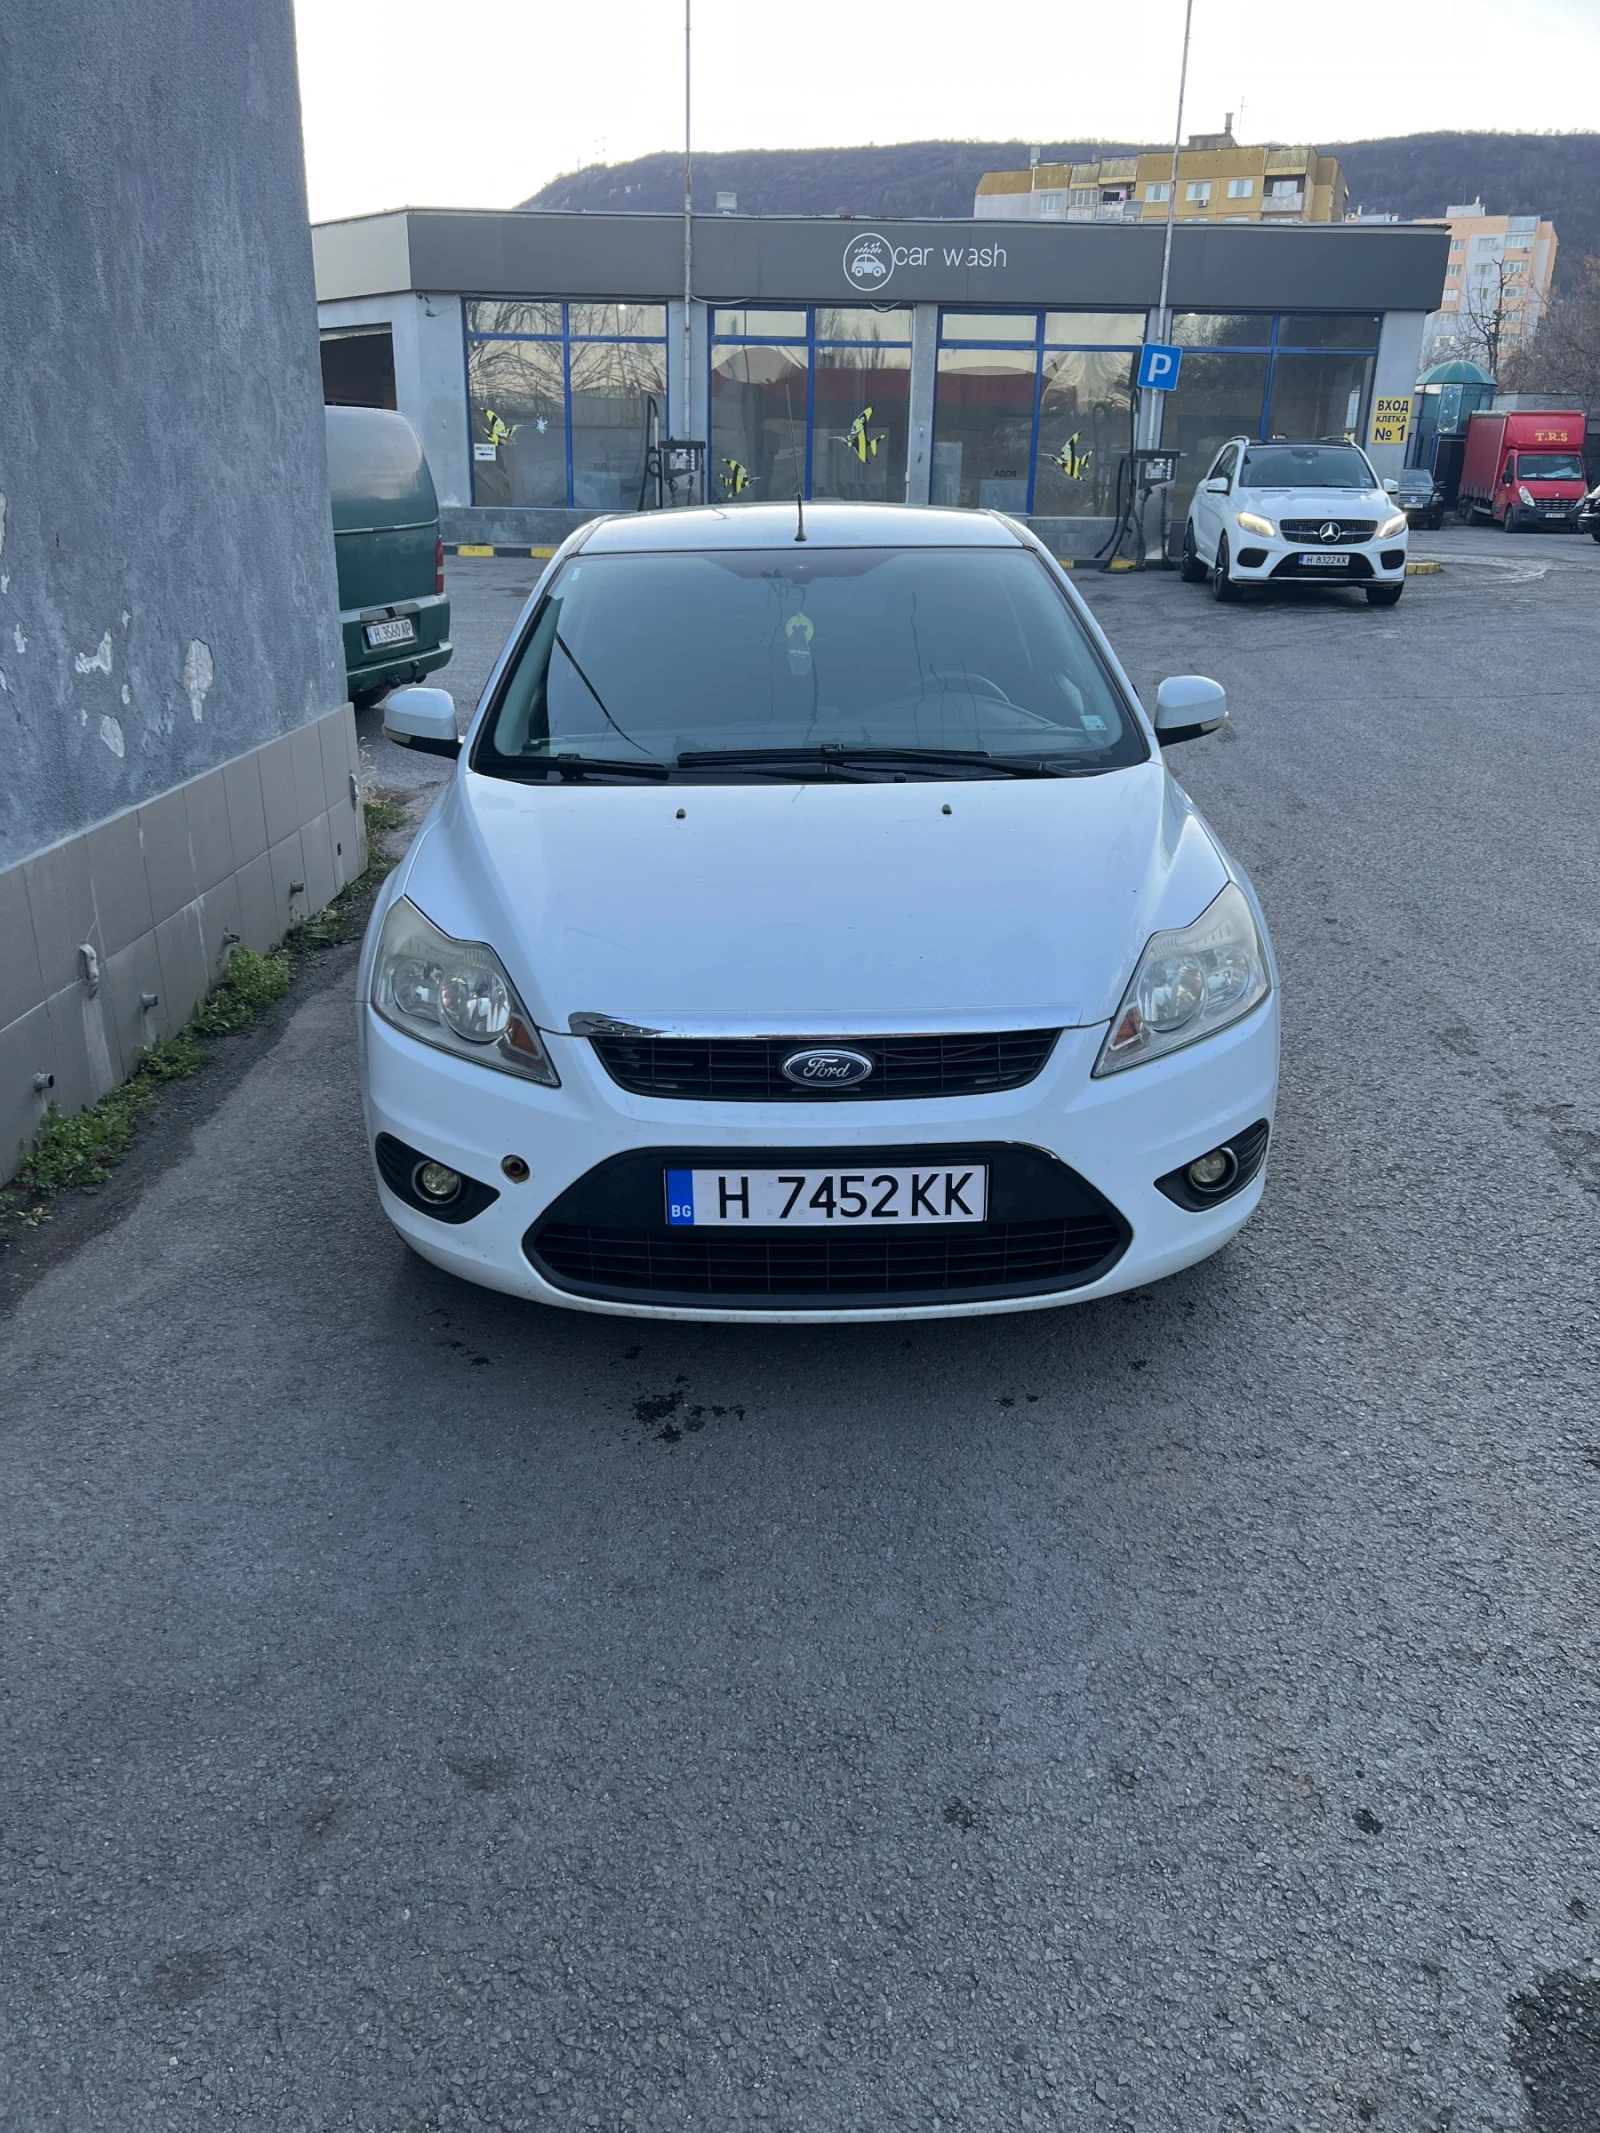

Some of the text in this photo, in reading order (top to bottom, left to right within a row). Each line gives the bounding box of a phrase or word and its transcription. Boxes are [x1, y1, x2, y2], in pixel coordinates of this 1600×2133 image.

[894, 242, 1007, 267] car wash
[1147, 352, 1172, 383] P
[1377, 400, 1409, 413] ВХОД
[1375, 415, 1407, 423] КЛЕТКА
[1397, 424, 1406, 441] 1
[803, 1057, 850, 1078] Ford
[718, 1176, 749, 1219] H
[671, 1204, 692, 1218] BG
